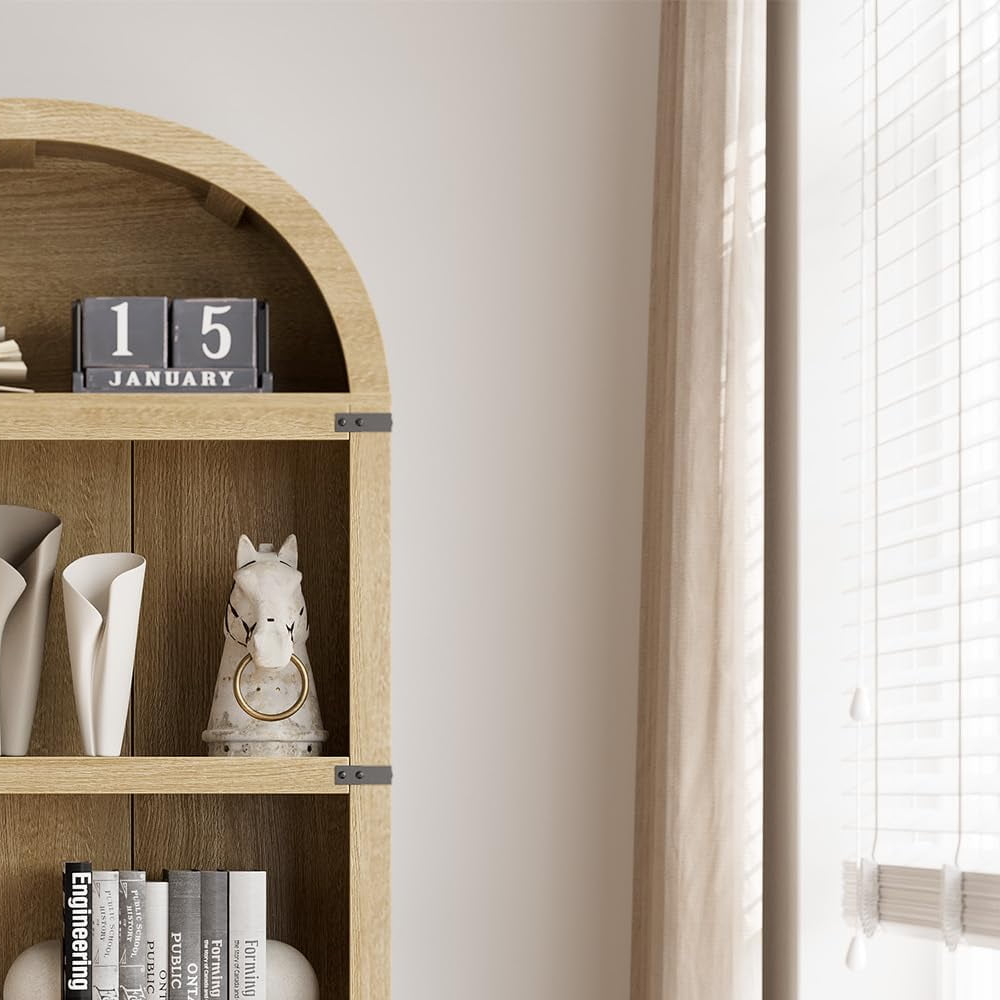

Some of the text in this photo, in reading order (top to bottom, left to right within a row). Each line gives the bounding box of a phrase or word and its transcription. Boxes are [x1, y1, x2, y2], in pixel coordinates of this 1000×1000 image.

[110, 301, 232, 360] 1 5
[108, 370, 234, 386] JANUARY
[68, 872, 92, 990] Engineering
[126, 905, 134, 942] HISTORY
[130, 889, 143, 958] PUBLIC SCHOOL
[146, 941, 155, 994] PUBLIC
[171, 932, 182, 989] PUBLIC
[210, 940, 223, 997] Forming
[242, 940, 259, 997] Forming
